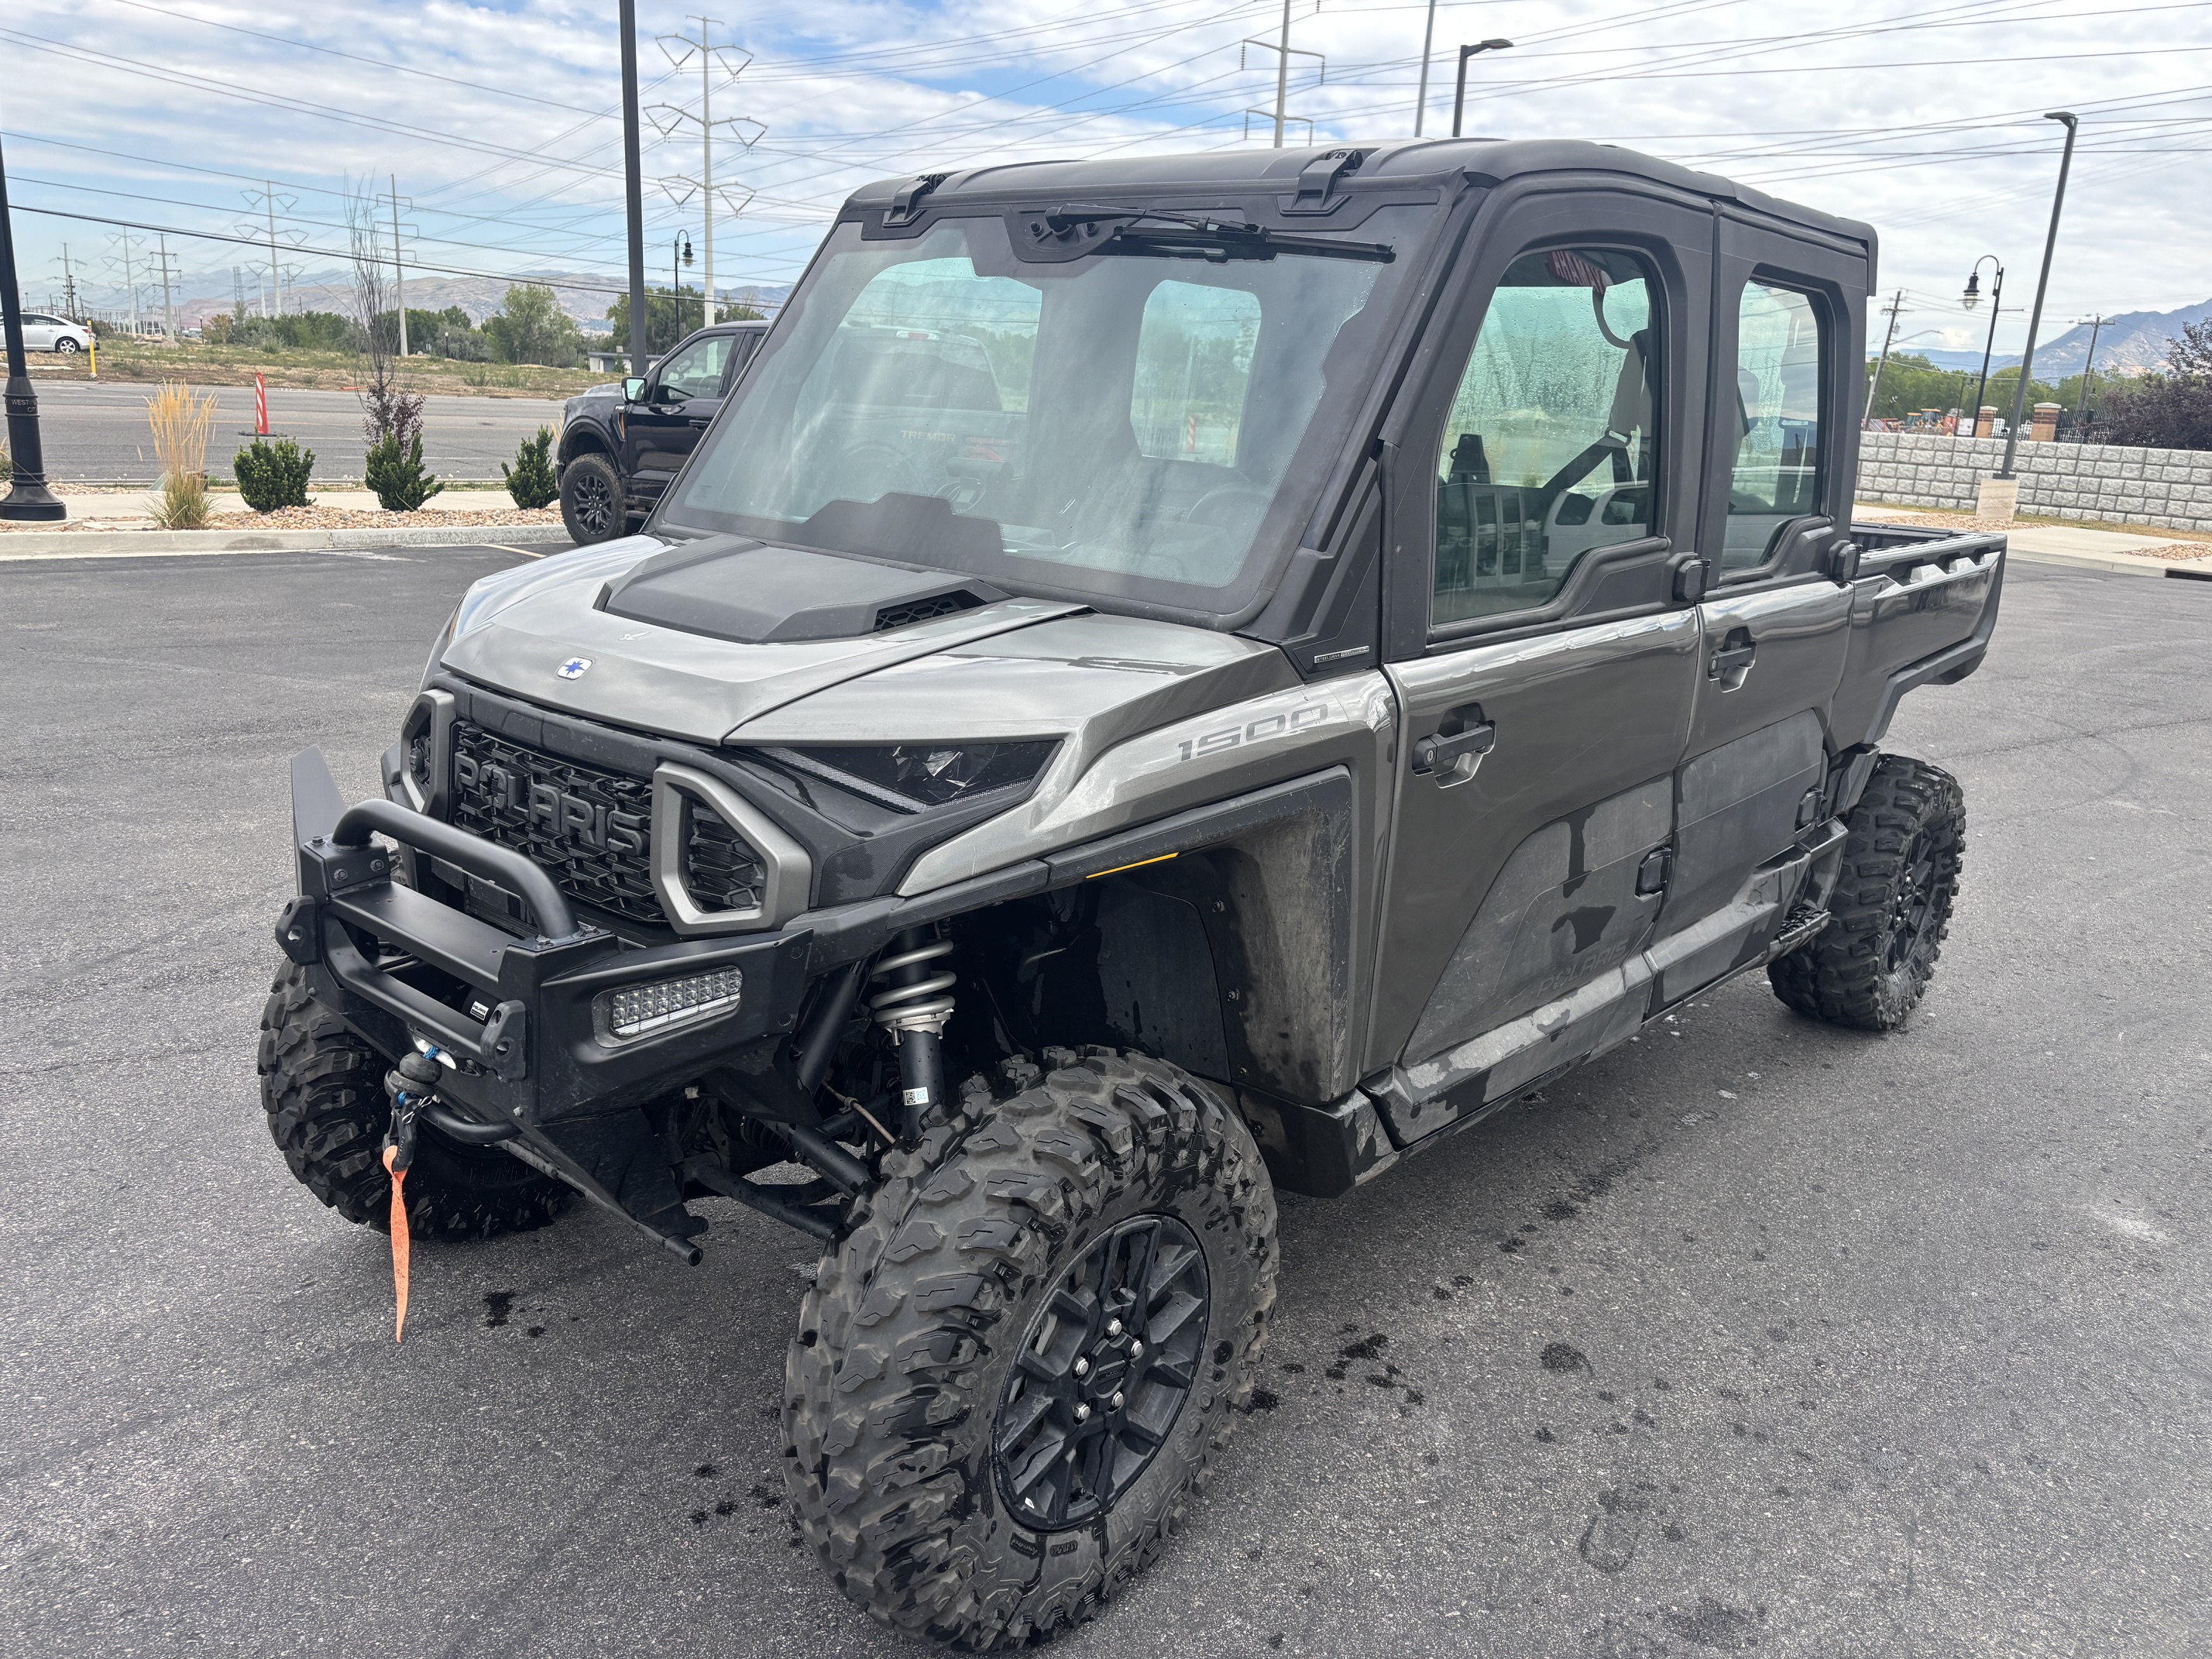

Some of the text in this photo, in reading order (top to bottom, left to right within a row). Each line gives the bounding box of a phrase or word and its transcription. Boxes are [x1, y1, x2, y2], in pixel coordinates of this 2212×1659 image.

[901, 431, 956, 441] TREMOR
[1178, 705, 1328, 761] 1500
[455, 750, 651, 857] POLARIS
[1537, 942, 1626, 998] POLARIS
